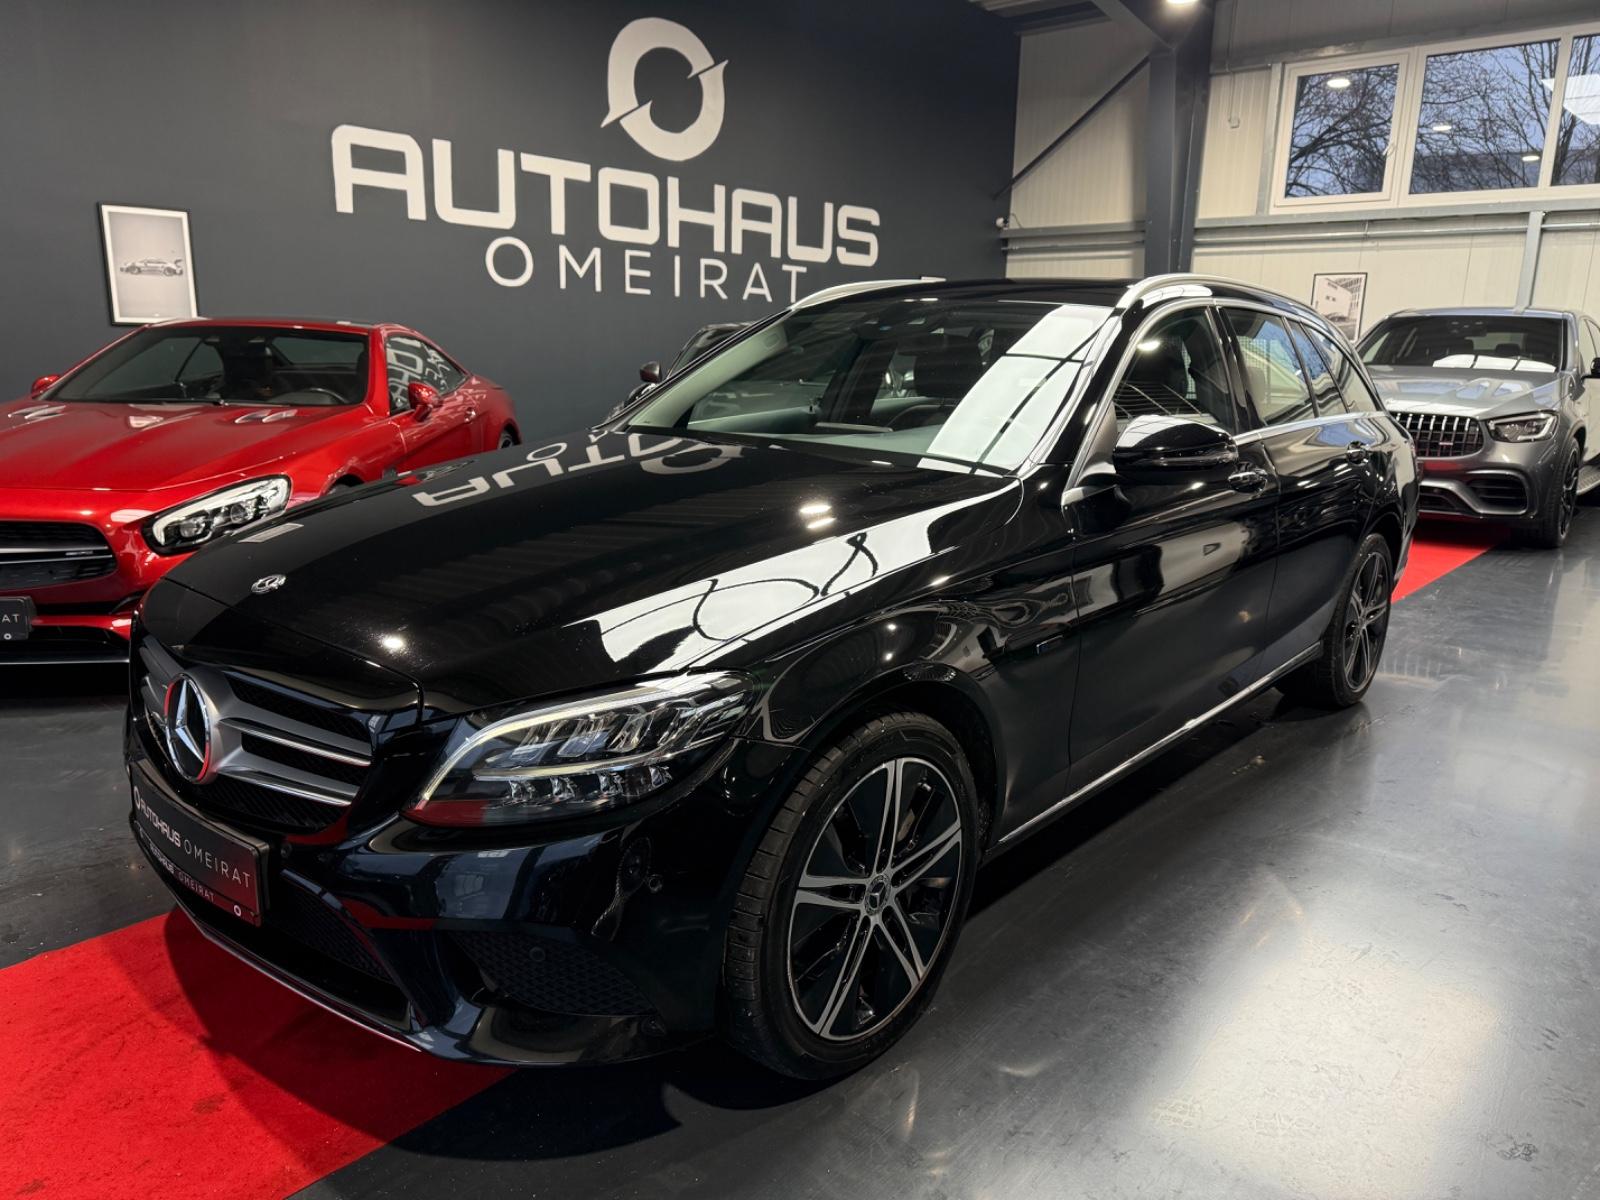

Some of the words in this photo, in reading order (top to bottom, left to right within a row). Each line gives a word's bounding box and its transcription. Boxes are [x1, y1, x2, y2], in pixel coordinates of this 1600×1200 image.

[331, 125, 880, 267] AUTOHAUS
[486, 237, 807, 303] OMEIRAT
[140, 797, 181, 848] AUTOHAUS
[184, 839, 251, 888] OMEIRAT
